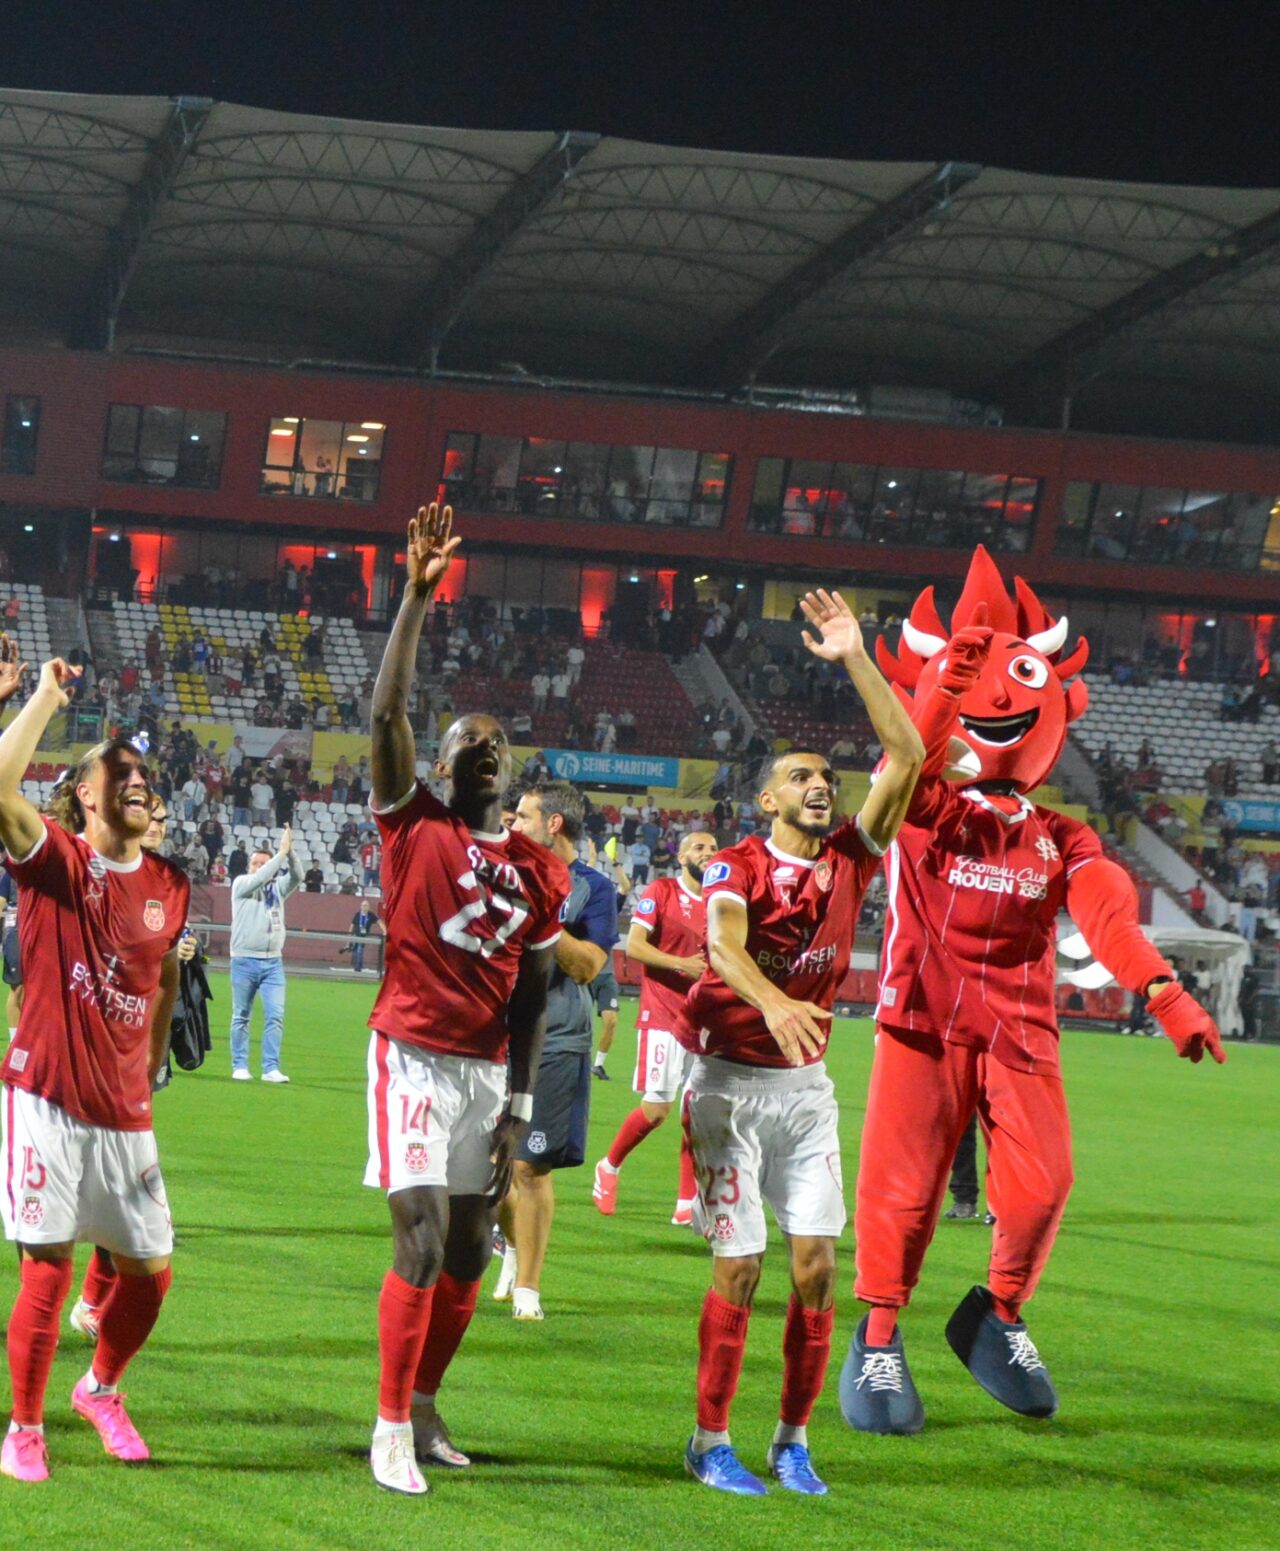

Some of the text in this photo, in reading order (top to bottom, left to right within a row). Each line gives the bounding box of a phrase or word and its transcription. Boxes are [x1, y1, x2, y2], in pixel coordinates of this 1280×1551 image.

[582, 757, 665, 777] SEINE-MARITIME
[948, 869, 1048, 900] ROUEN 1899
[439, 870, 529, 958] 27
[757, 943, 837, 971] BOUTSEN
[69, 981, 145, 1027] AVITION
[655, 1043, 665, 1064] 6
[399, 1094, 432, 1136] 14
[20, 1145, 46, 1190] 15
[704, 1165, 741, 1206] 23
